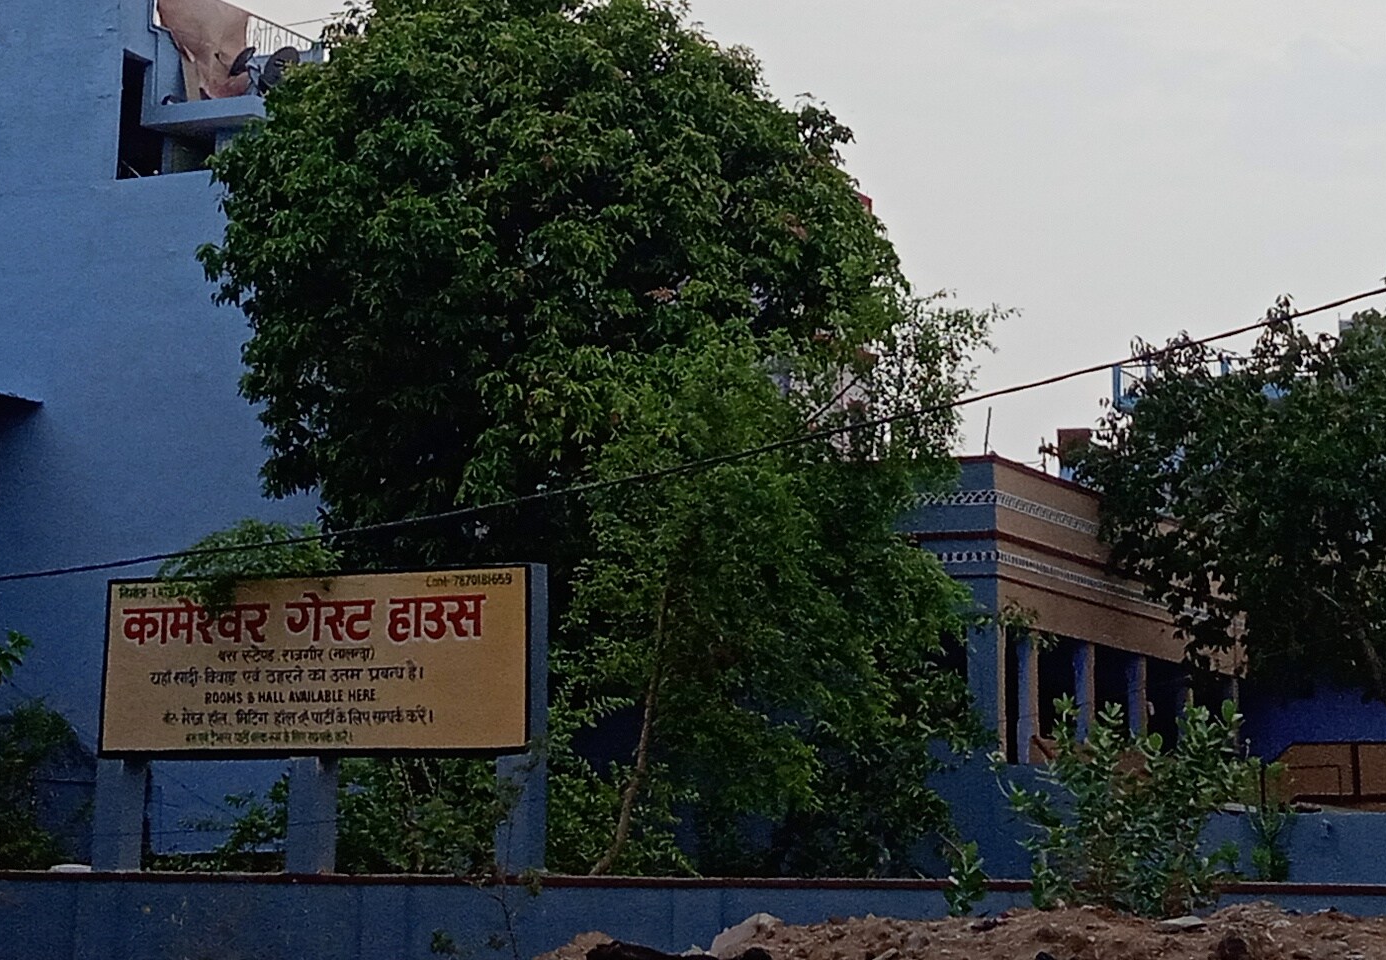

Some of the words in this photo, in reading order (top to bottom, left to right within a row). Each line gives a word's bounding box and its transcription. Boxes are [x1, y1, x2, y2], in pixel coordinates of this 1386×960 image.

[285, 592, 376, 642] गेस्ट
[387, 594, 487, 641] हाउस
[308, 669, 326, 682] का
[204, 692, 243, 704] ROOMS
[258, 691, 286, 703] HALL
[289, 689, 344, 703] AVAILABLE
[348, 688, 376, 701] HERE
